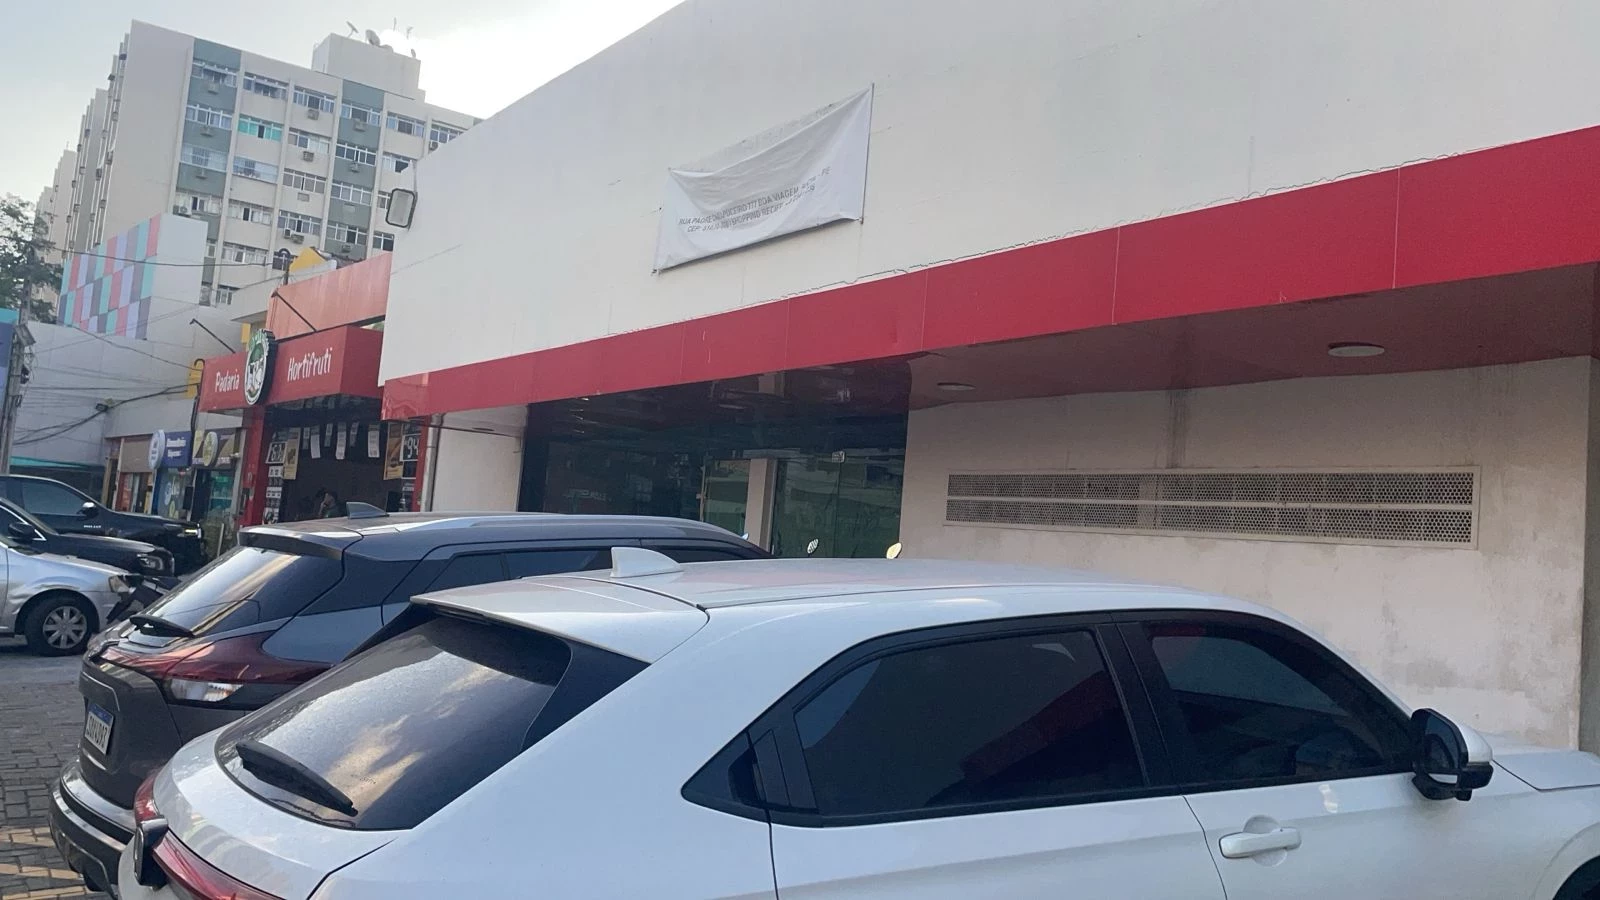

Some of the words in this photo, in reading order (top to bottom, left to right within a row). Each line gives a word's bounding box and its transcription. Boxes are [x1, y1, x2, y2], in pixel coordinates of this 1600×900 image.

[679, 217, 692, 225] RUA
[772, 186, 799, 201] VIAGEM
[215, 368, 240, 392] Padaria
[287, 347, 333, 382] Hortifruti
